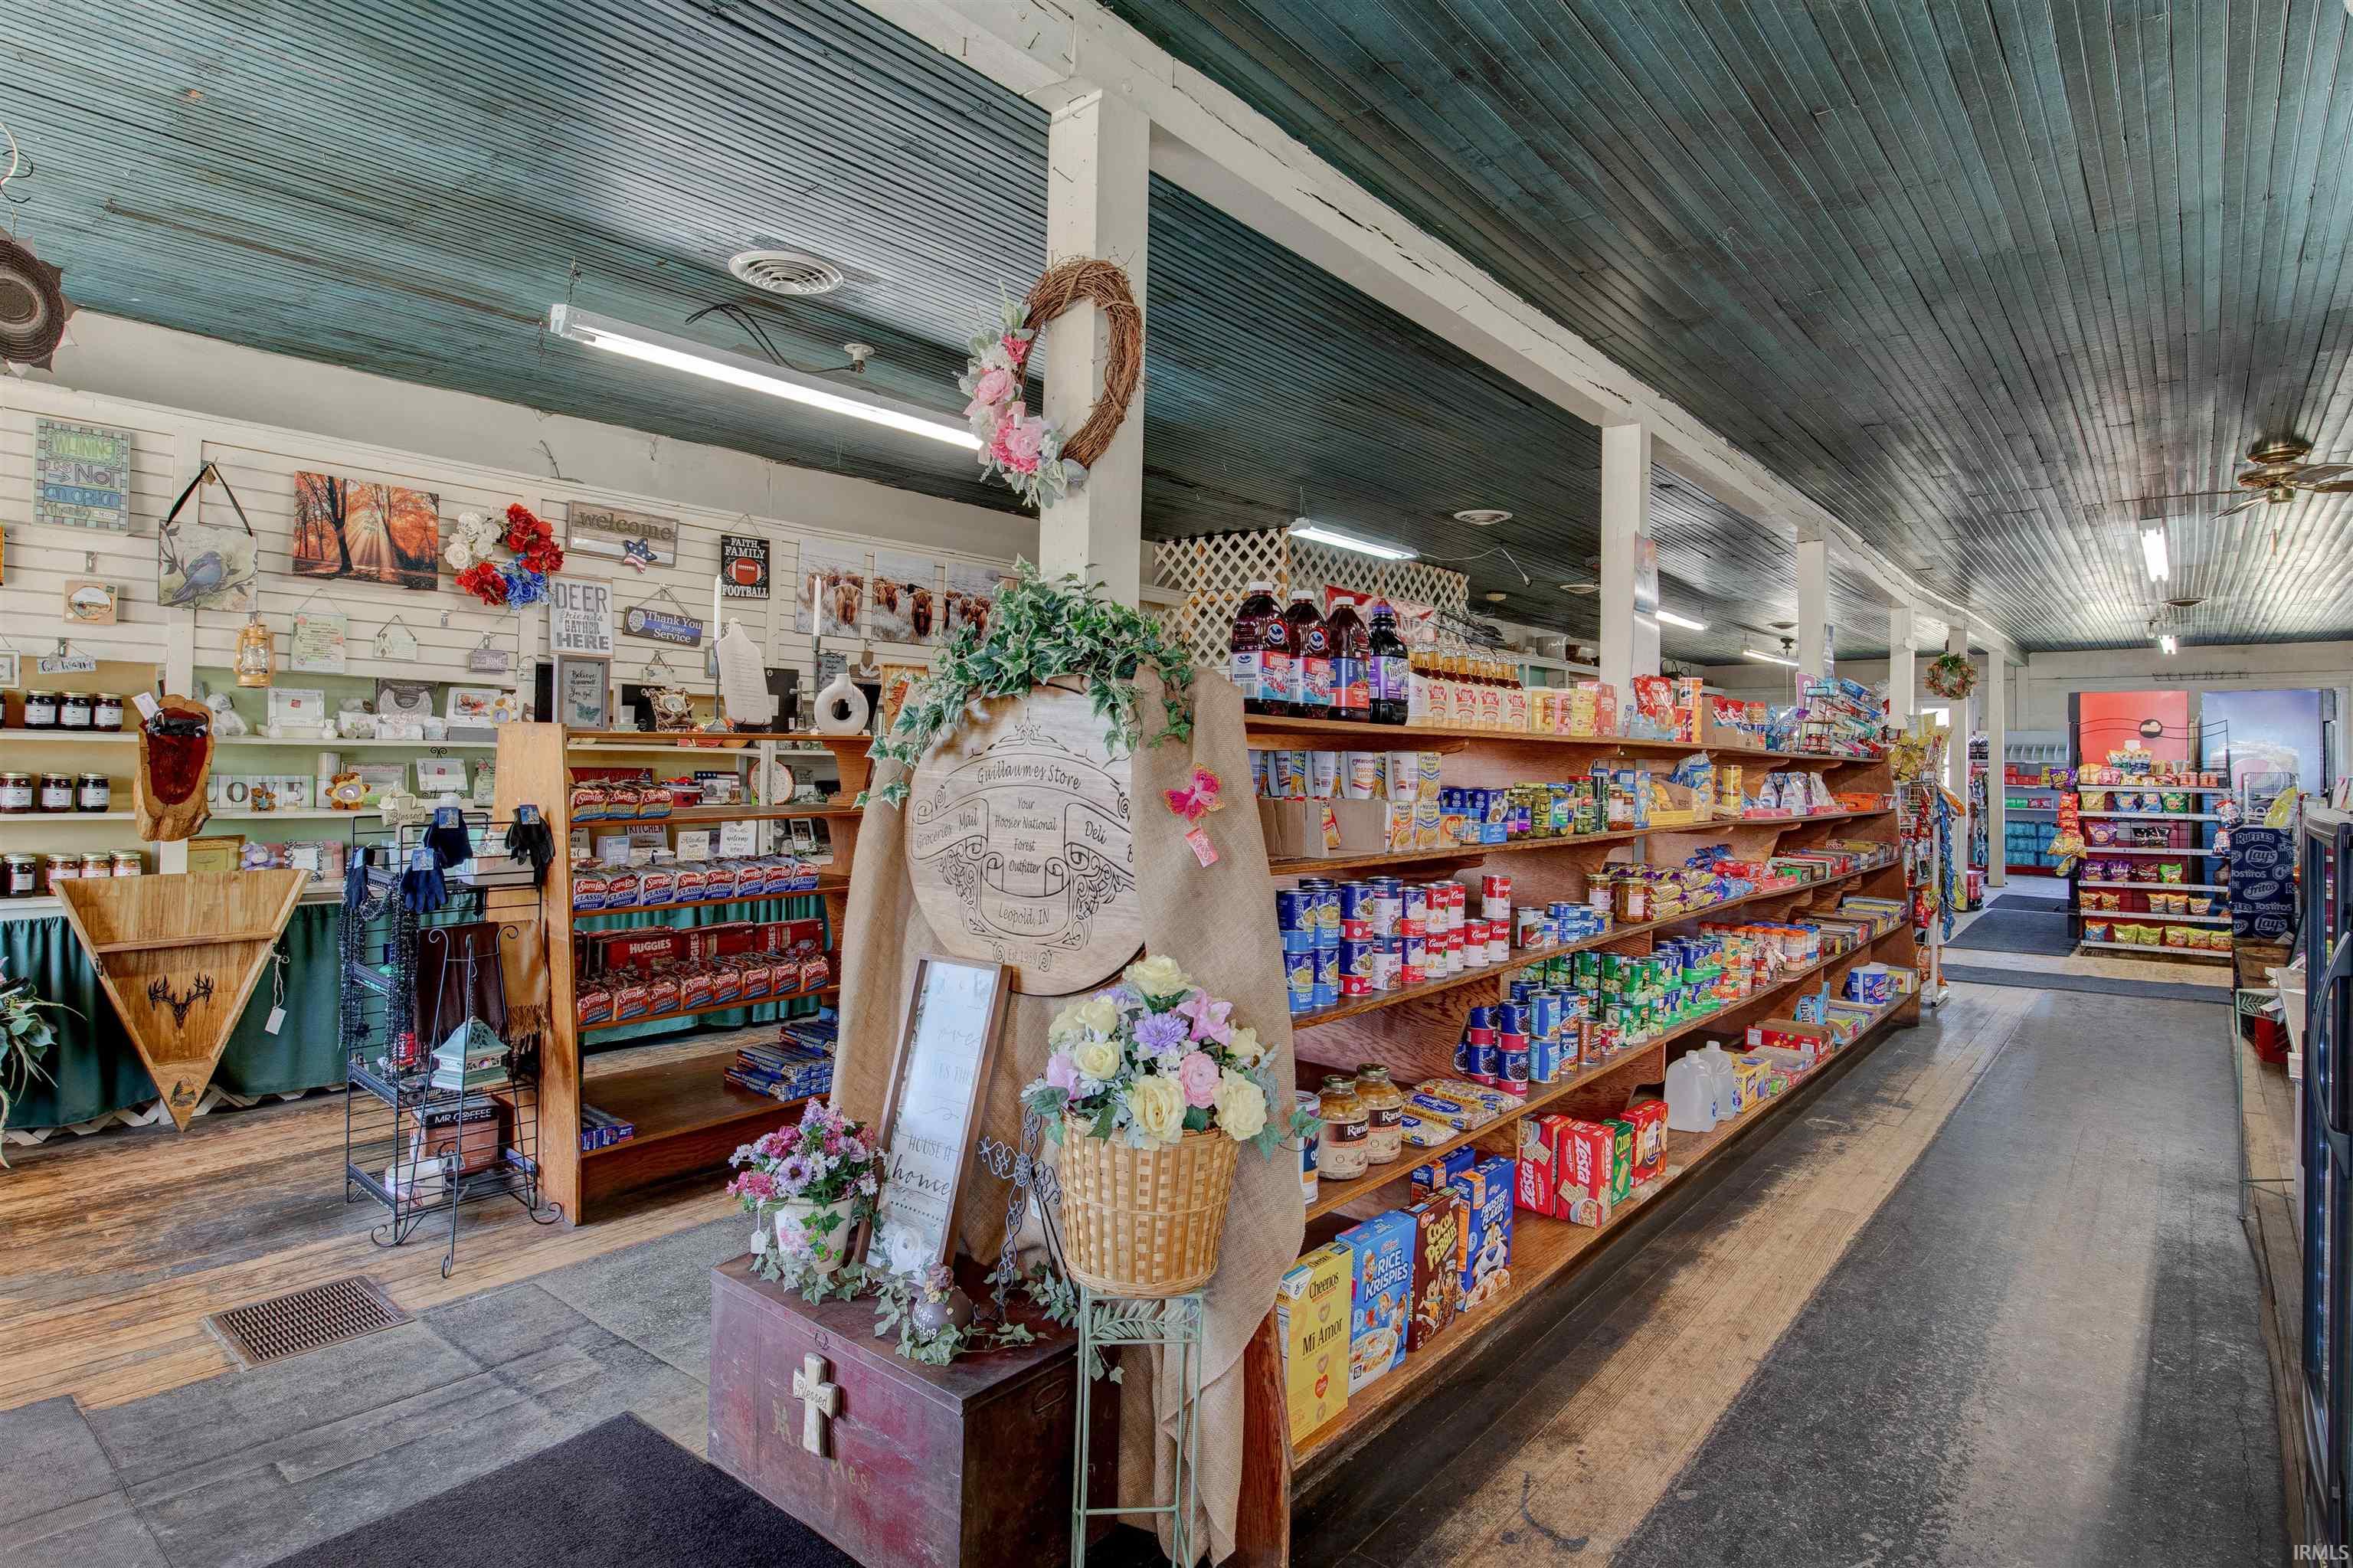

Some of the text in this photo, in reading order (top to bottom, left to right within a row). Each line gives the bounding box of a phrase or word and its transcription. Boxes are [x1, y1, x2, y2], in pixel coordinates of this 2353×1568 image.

[74, 463, 121, 488] NOT
[579, 512, 674, 541] welcome
[731, 538, 760, 549] FAITH,
[725, 545, 765, 559] FAMILY
[555, 583, 607, 613] DEER
[722, 584, 768, 598] FOOTBALL
[564, 619, 600, 635] GATHER
[646, 611, 702, 630] Thank You
[653, 629, 691, 643] Service
[671, 625, 686, 634] your
[556, 633, 609, 650] HERE
[1048, 764, 1082, 790] Store
[2053, 772, 2070, 783] Takis
[1017, 797, 1036, 810] Your
[391, 811, 422, 824] Blessed
[957, 807, 978, 833] Mail
[995, 814, 1058, 831] Hoosier National
[629, 825, 663, 834] KITCHEN
[1085, 820, 1108, 844] Deli
[1013, 838, 1036, 853] Forest
[2236, 832, 2274, 844] RUFFLES
[1009, 859, 1042, 875] Outfitter
[2231, 869, 2266, 879] Tostitos
[708, 884, 731, 892] CLASSIC
[740, 881, 763, 891] CLASSIC
[794, 876, 817, 884] CLASSIC
[575, 894, 604, 902] CLASSIC
[609, 889, 636, 901] CLASSIC
[645, 887, 671, 899] CLASSIC
[998, 902, 1050, 927] Leopold, IN
[2255, 902, 2292, 912] Tostitos
[630, 939, 672, 954] HUGGIES
[434, 1108, 492, 1124] MR COFFEE
[1382, 1109, 1402, 1122] Rand
[1347, 1121, 1369, 1137] Rand
[909, 1134, 941, 1161] HOUSE
[1615, 1133, 1631, 1154] CLUB
[1575, 1134, 1592, 1184] Zesta
[892, 1154, 951, 1196] home
[1520, 1161, 1536, 1210] Zesta
[1481, 1188, 1508, 1218] FROSTED
[1482, 1204, 1505, 1226] FLAKES
[1427, 1210, 1455, 1245] COCOA
[1425, 1226, 1458, 1272] PEBBLES
[1377, 1249, 1402, 1277] RICE
[1309, 1272, 1340, 1299] Cheerios
[1365, 1262, 1409, 1302] KRISPIES
[1302, 1318, 1343, 1357] Mi Amor
[794, 1380, 829, 1410] Blessed
